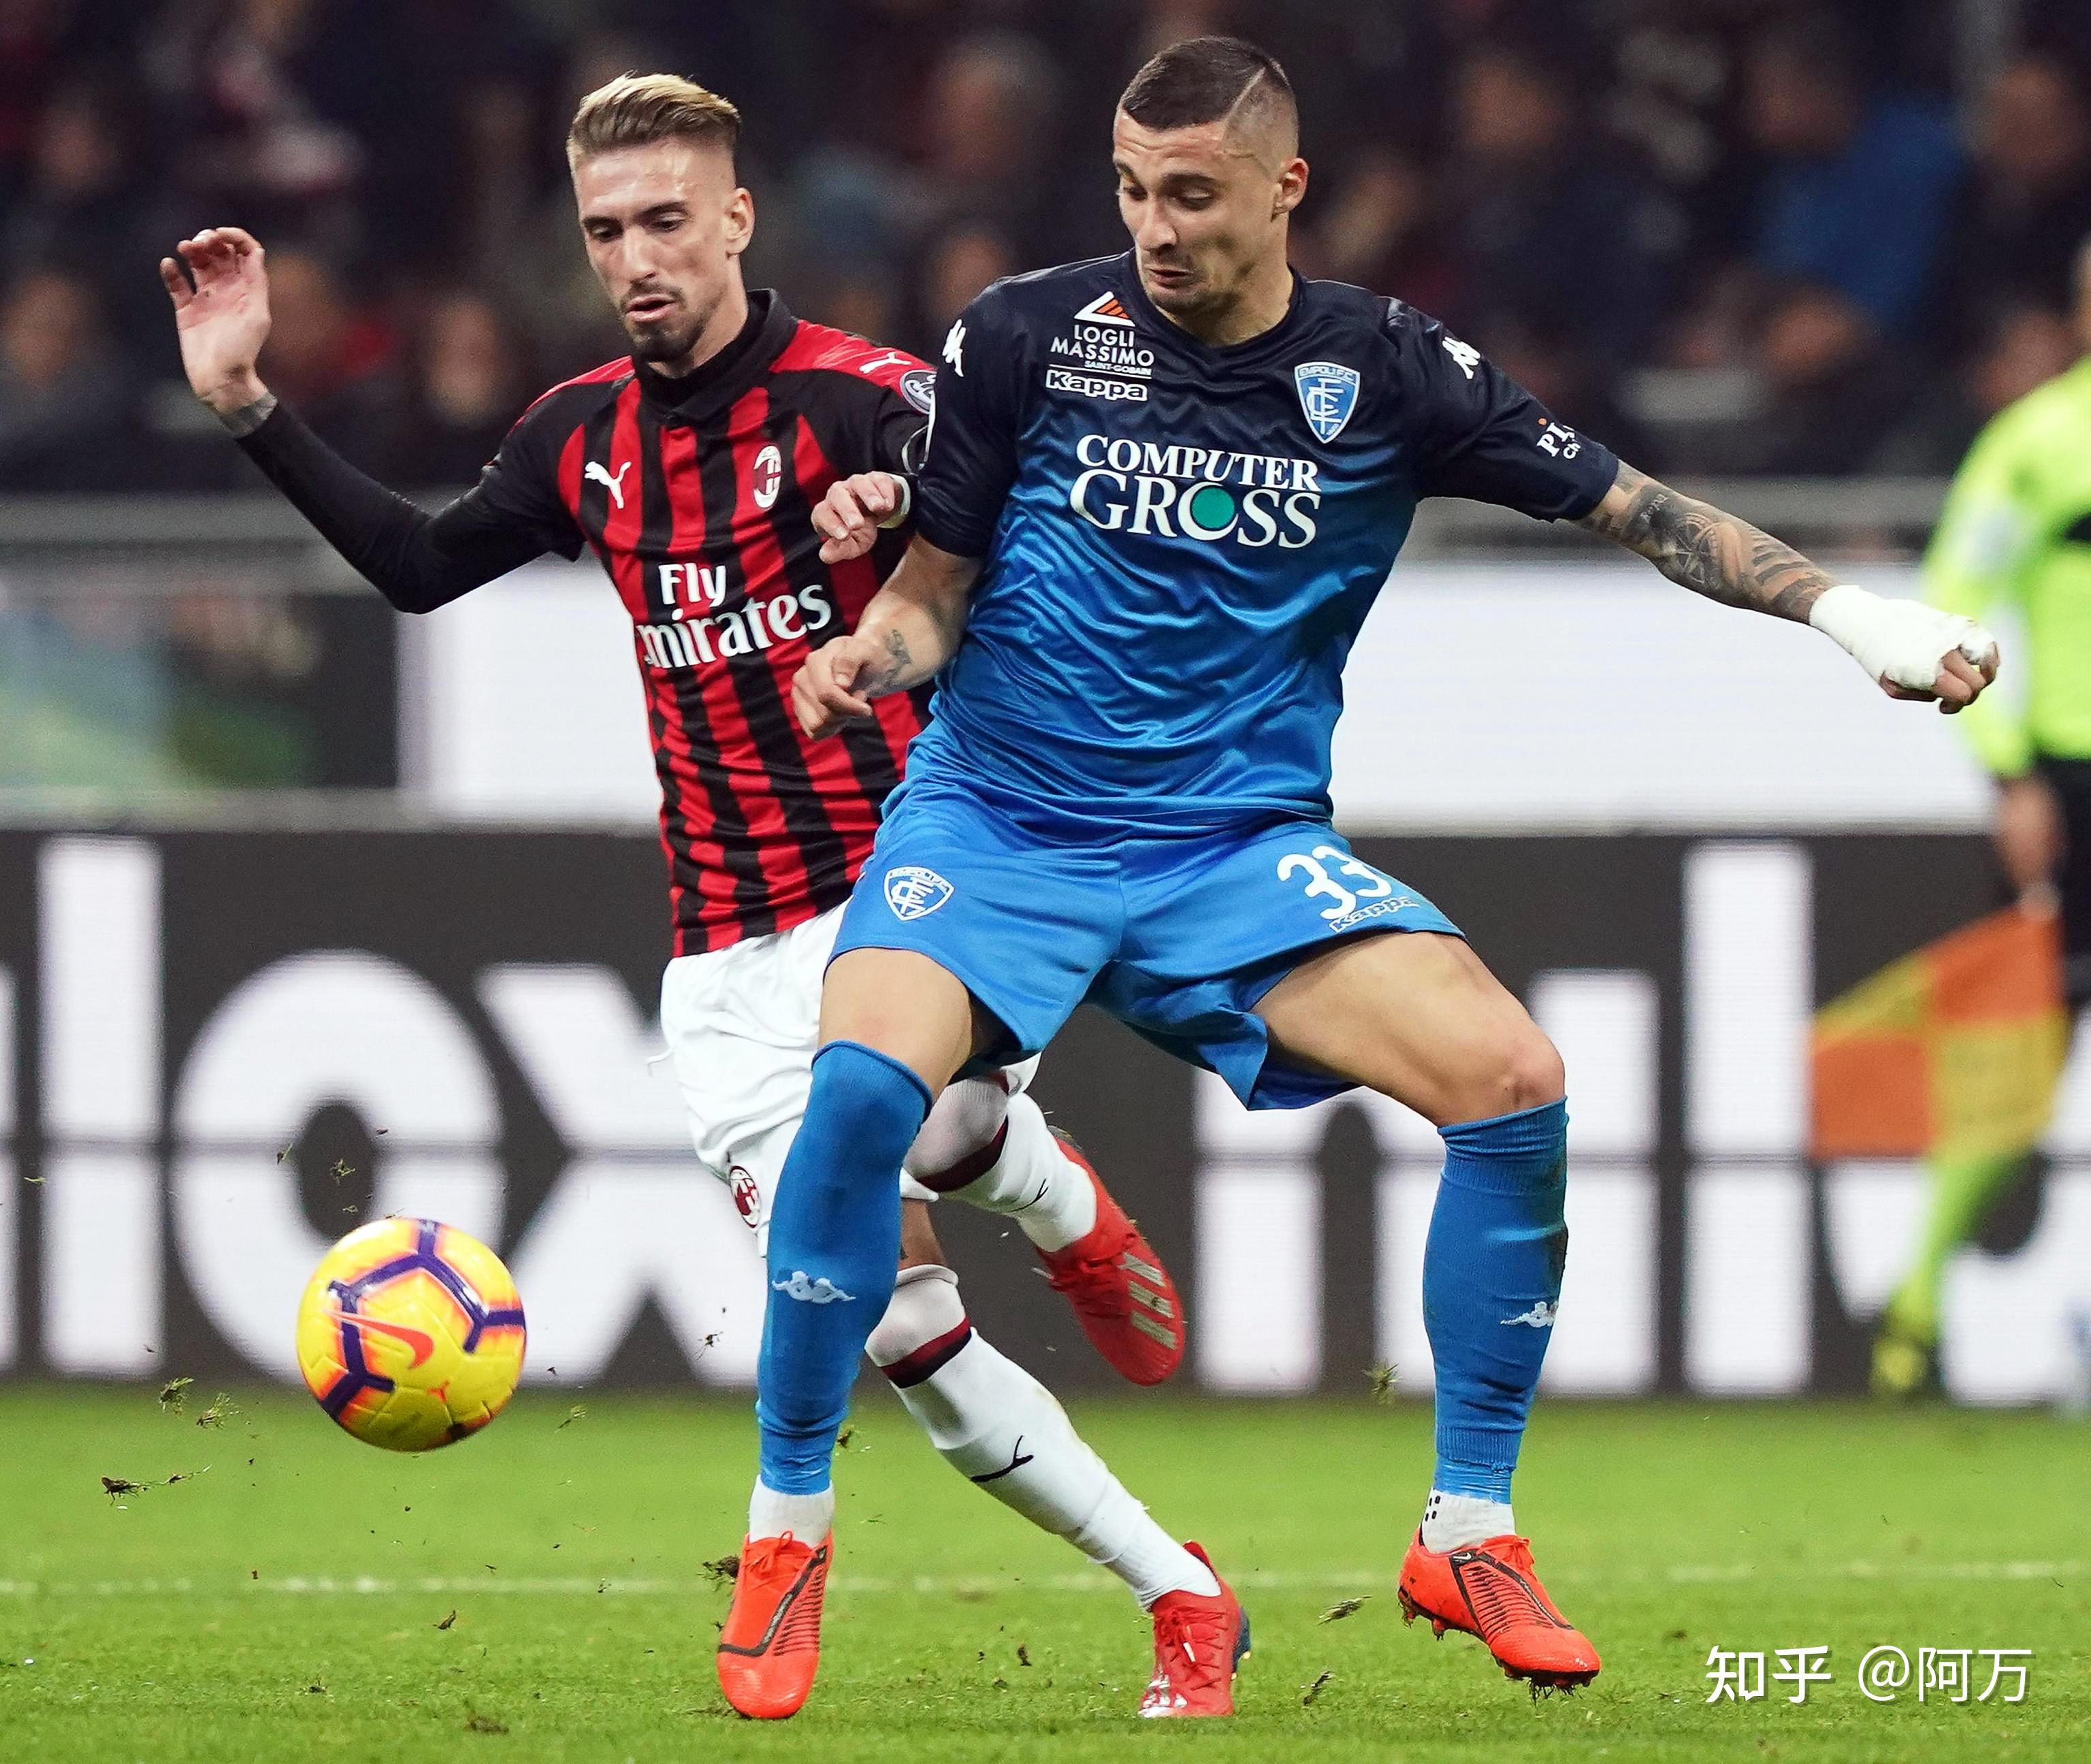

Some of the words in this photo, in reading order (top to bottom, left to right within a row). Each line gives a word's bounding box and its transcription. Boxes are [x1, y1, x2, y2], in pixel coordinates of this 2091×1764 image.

[1050, 336, 1155, 367] MASSIMO
[1073, 324, 1135, 348] LOGLI
[1046, 370, 1148, 402] Kappa
[1084, 360, 1152, 376] SAINT-GOBAIN
[1075, 434, 1322, 492] COMPUTER
[1069, 468, 1322, 549] GROSS
[658, 562, 726, 607] Fly
[636, 584, 832, 669] mirates
[1276, 845, 1392, 919] 33
